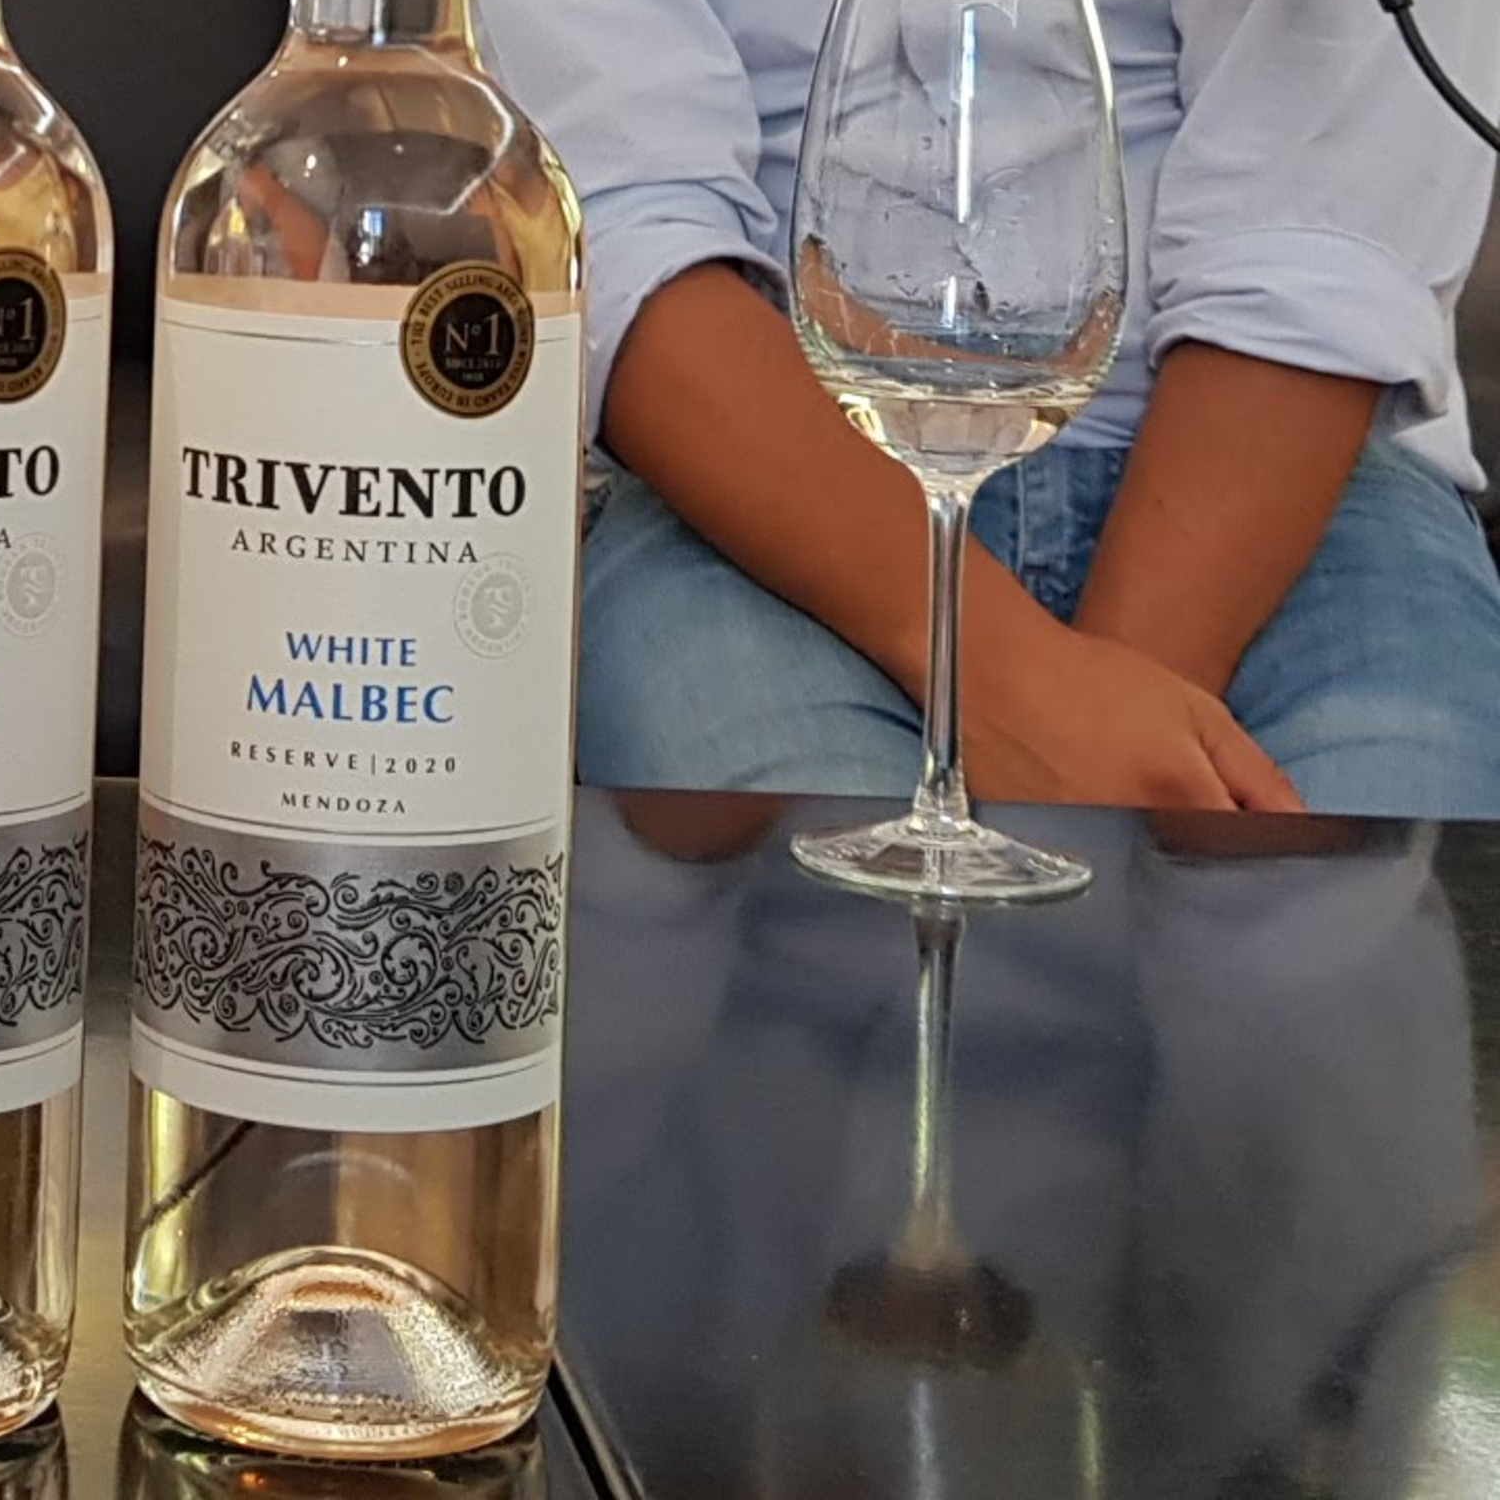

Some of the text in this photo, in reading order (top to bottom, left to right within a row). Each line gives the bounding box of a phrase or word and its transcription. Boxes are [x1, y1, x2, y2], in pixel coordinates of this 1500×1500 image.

[419, 287, 444, 317] BEST
[181, 445, 527, 520] TRIVENTO
[229, 528, 480, 565] ARGENTINA
[285, 631, 418, 668] WHITE
[245, 673, 455, 724] MALBEC
[280, 792, 408, 814] MENDOZA
